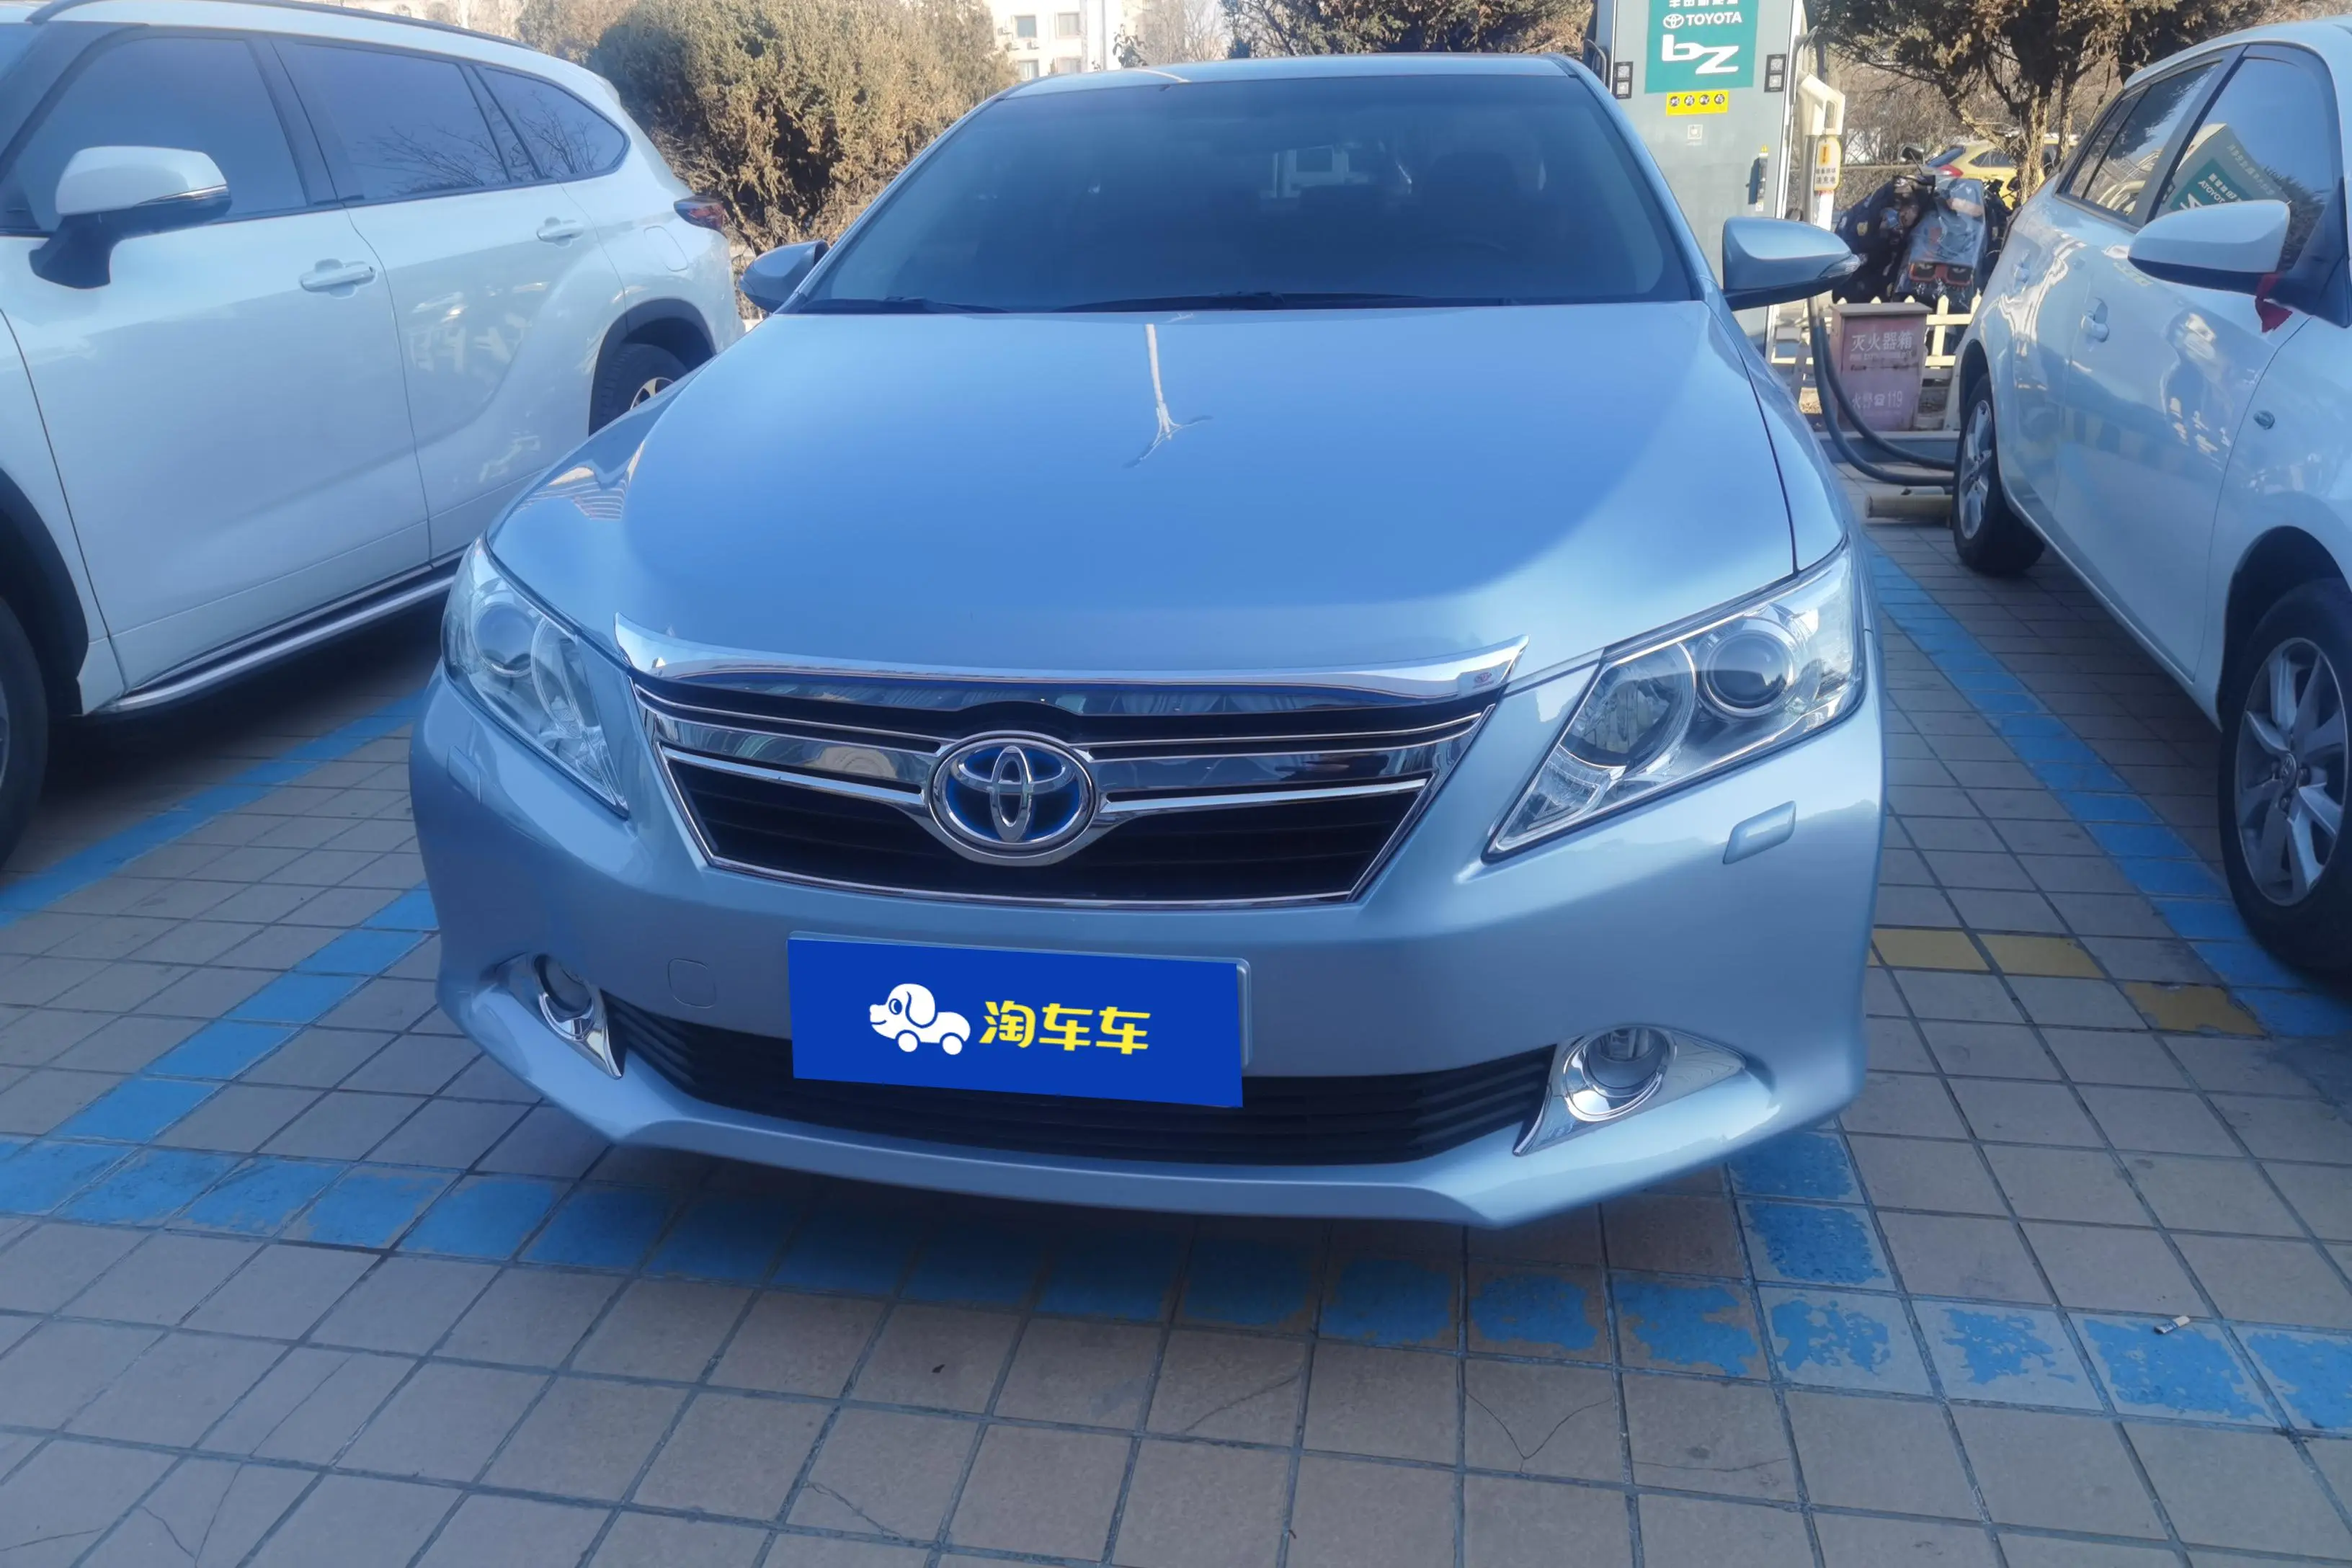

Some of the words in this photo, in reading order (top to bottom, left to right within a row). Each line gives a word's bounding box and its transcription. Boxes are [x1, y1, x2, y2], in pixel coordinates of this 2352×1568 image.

[1686, 12, 1742, 26] TOYOTA
[1851, 331, 1914, 352] 灭火器箱
[1887, 391, 1904, 408] 119
